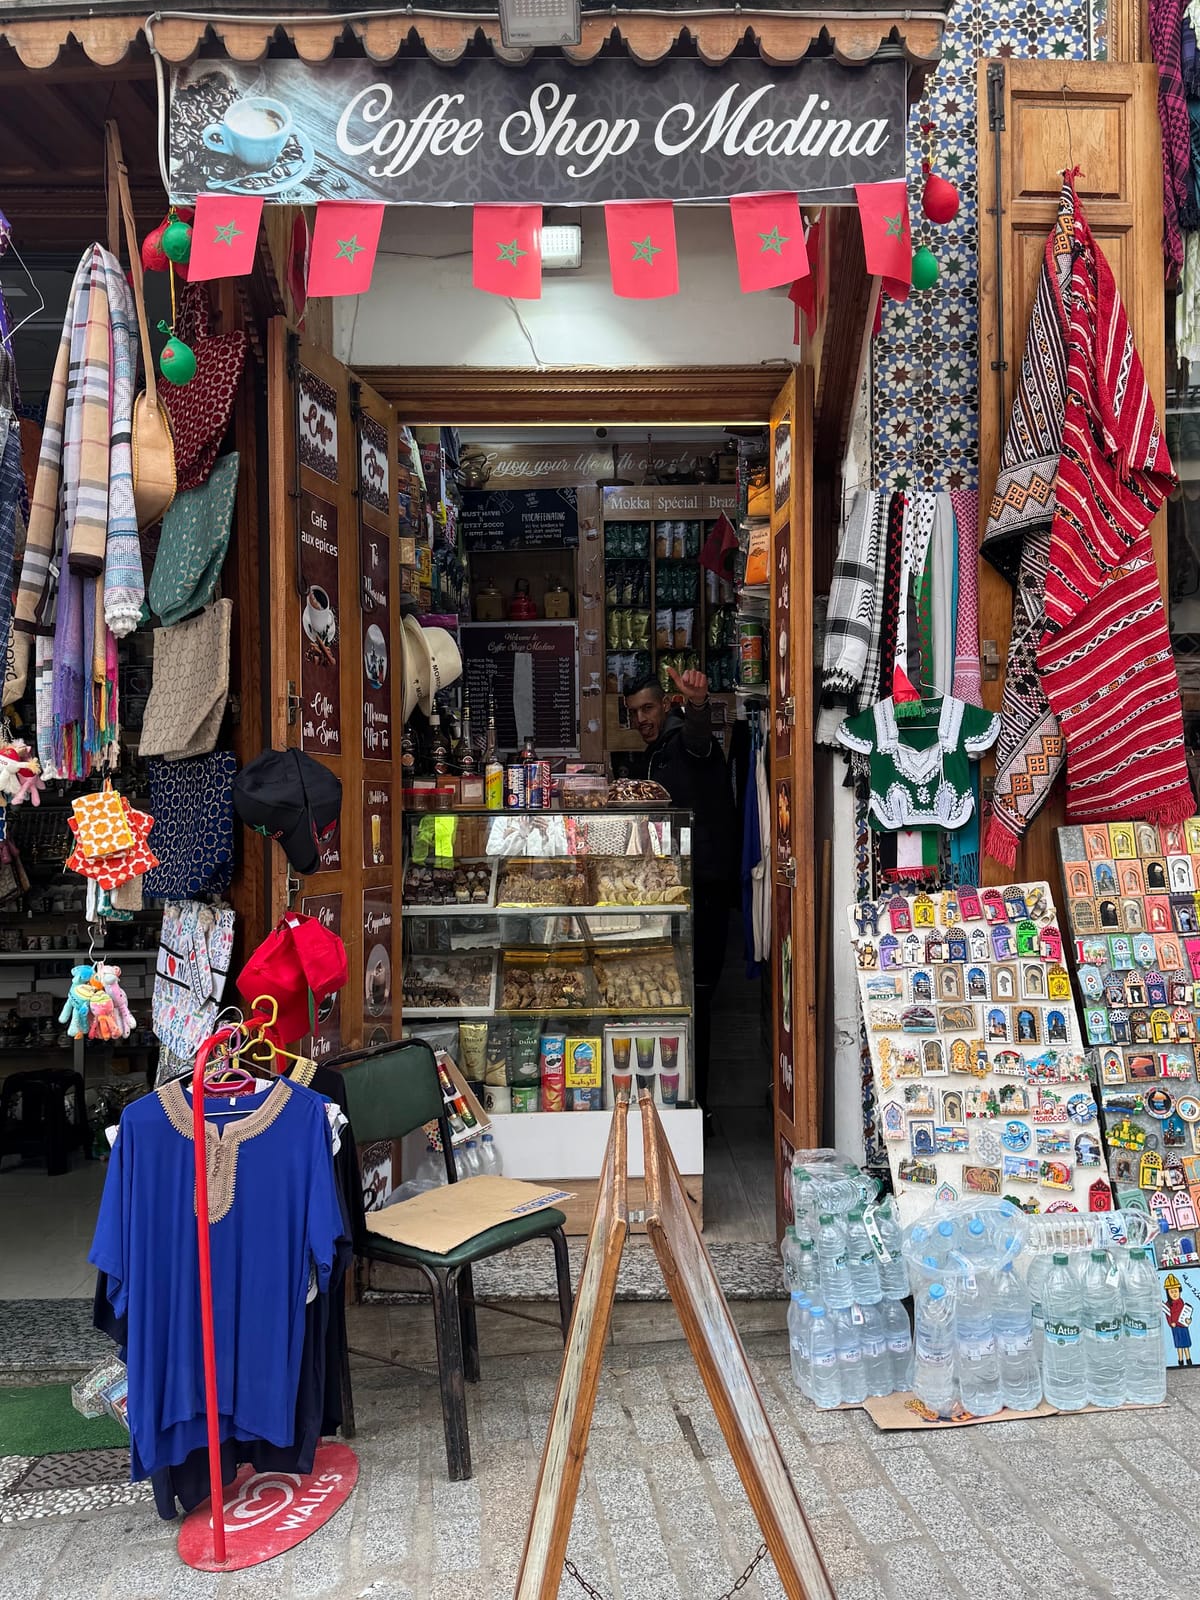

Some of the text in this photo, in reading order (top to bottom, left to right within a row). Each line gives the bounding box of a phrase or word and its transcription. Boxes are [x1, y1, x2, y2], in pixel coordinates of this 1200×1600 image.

[336, 82, 889, 178] Coffee Shop Medina
[574, 453, 598, 476] life
[602, 452, 633, 471] wth
[611, 496, 650, 510] Mokka
[658, 495, 697, 512] Spécial
[311, 510, 328, 531] Cafe
[301, 530, 338, 558] aux epices
[1033, 1113, 1068, 1123] MOROCCO
[1057, 1325, 1078, 1335] Atlas
[275, 1473, 343, 1532] WALL'S
